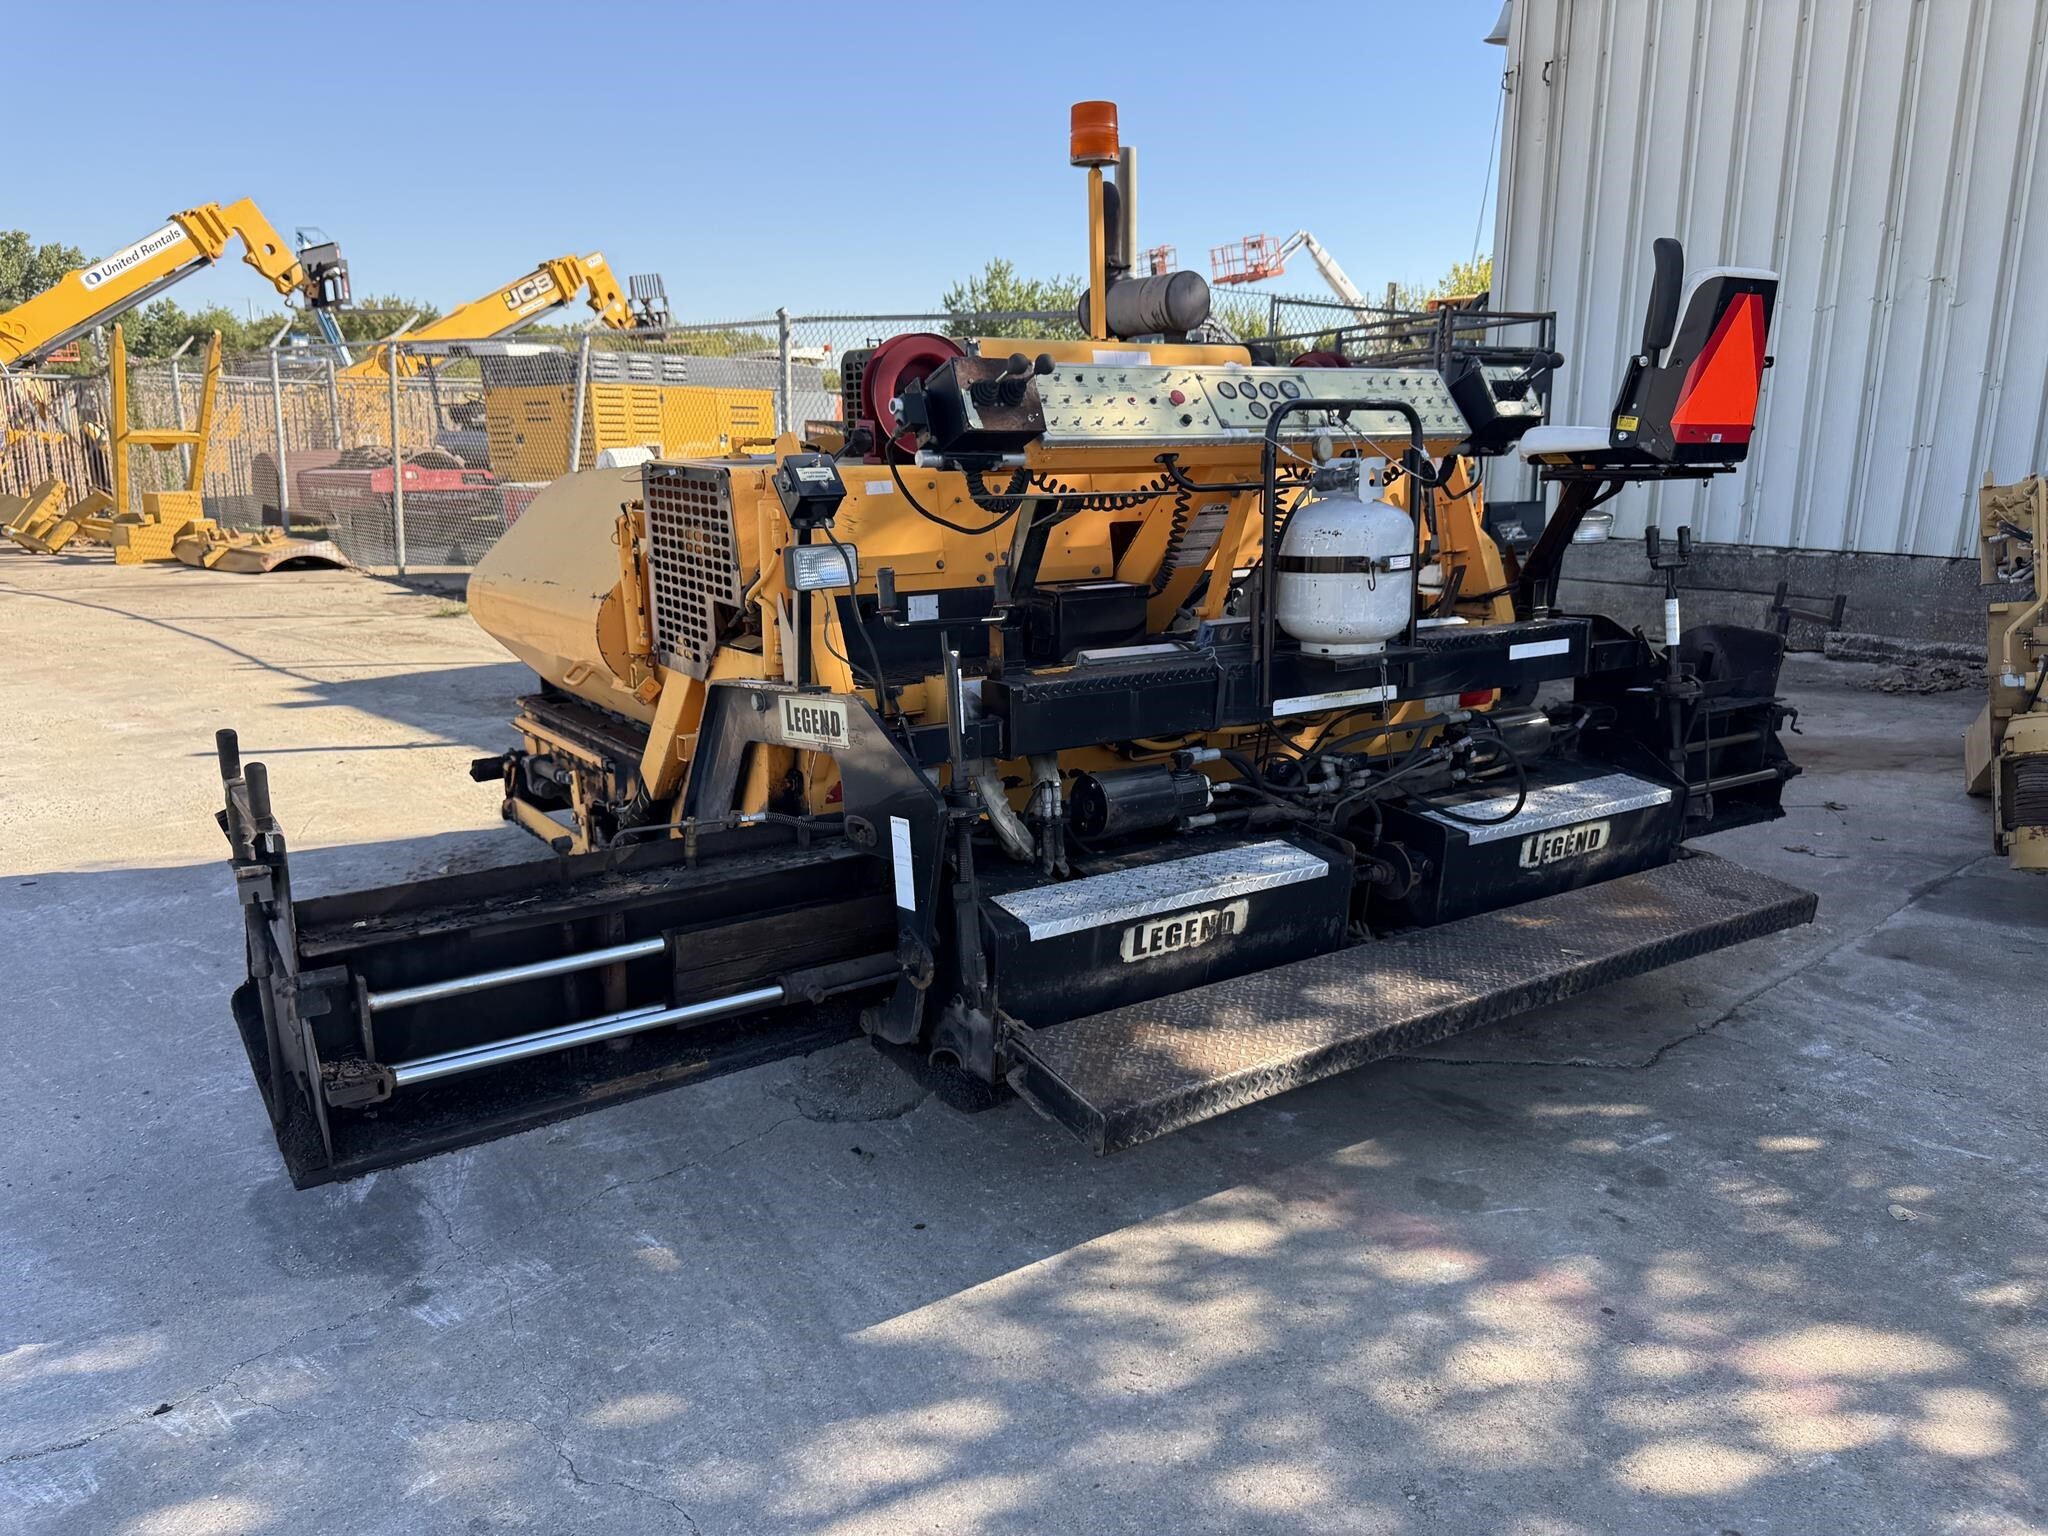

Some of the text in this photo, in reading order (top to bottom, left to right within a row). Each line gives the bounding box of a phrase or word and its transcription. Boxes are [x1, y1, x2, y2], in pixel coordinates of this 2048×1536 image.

[101, 229, 181, 276] United Rentals
[502, 271, 556, 310] JCB
[785, 699, 841, 737] LEGEND
[1528, 829, 1601, 863] LEGEND
[1132, 910, 1236, 957] LEGEND
